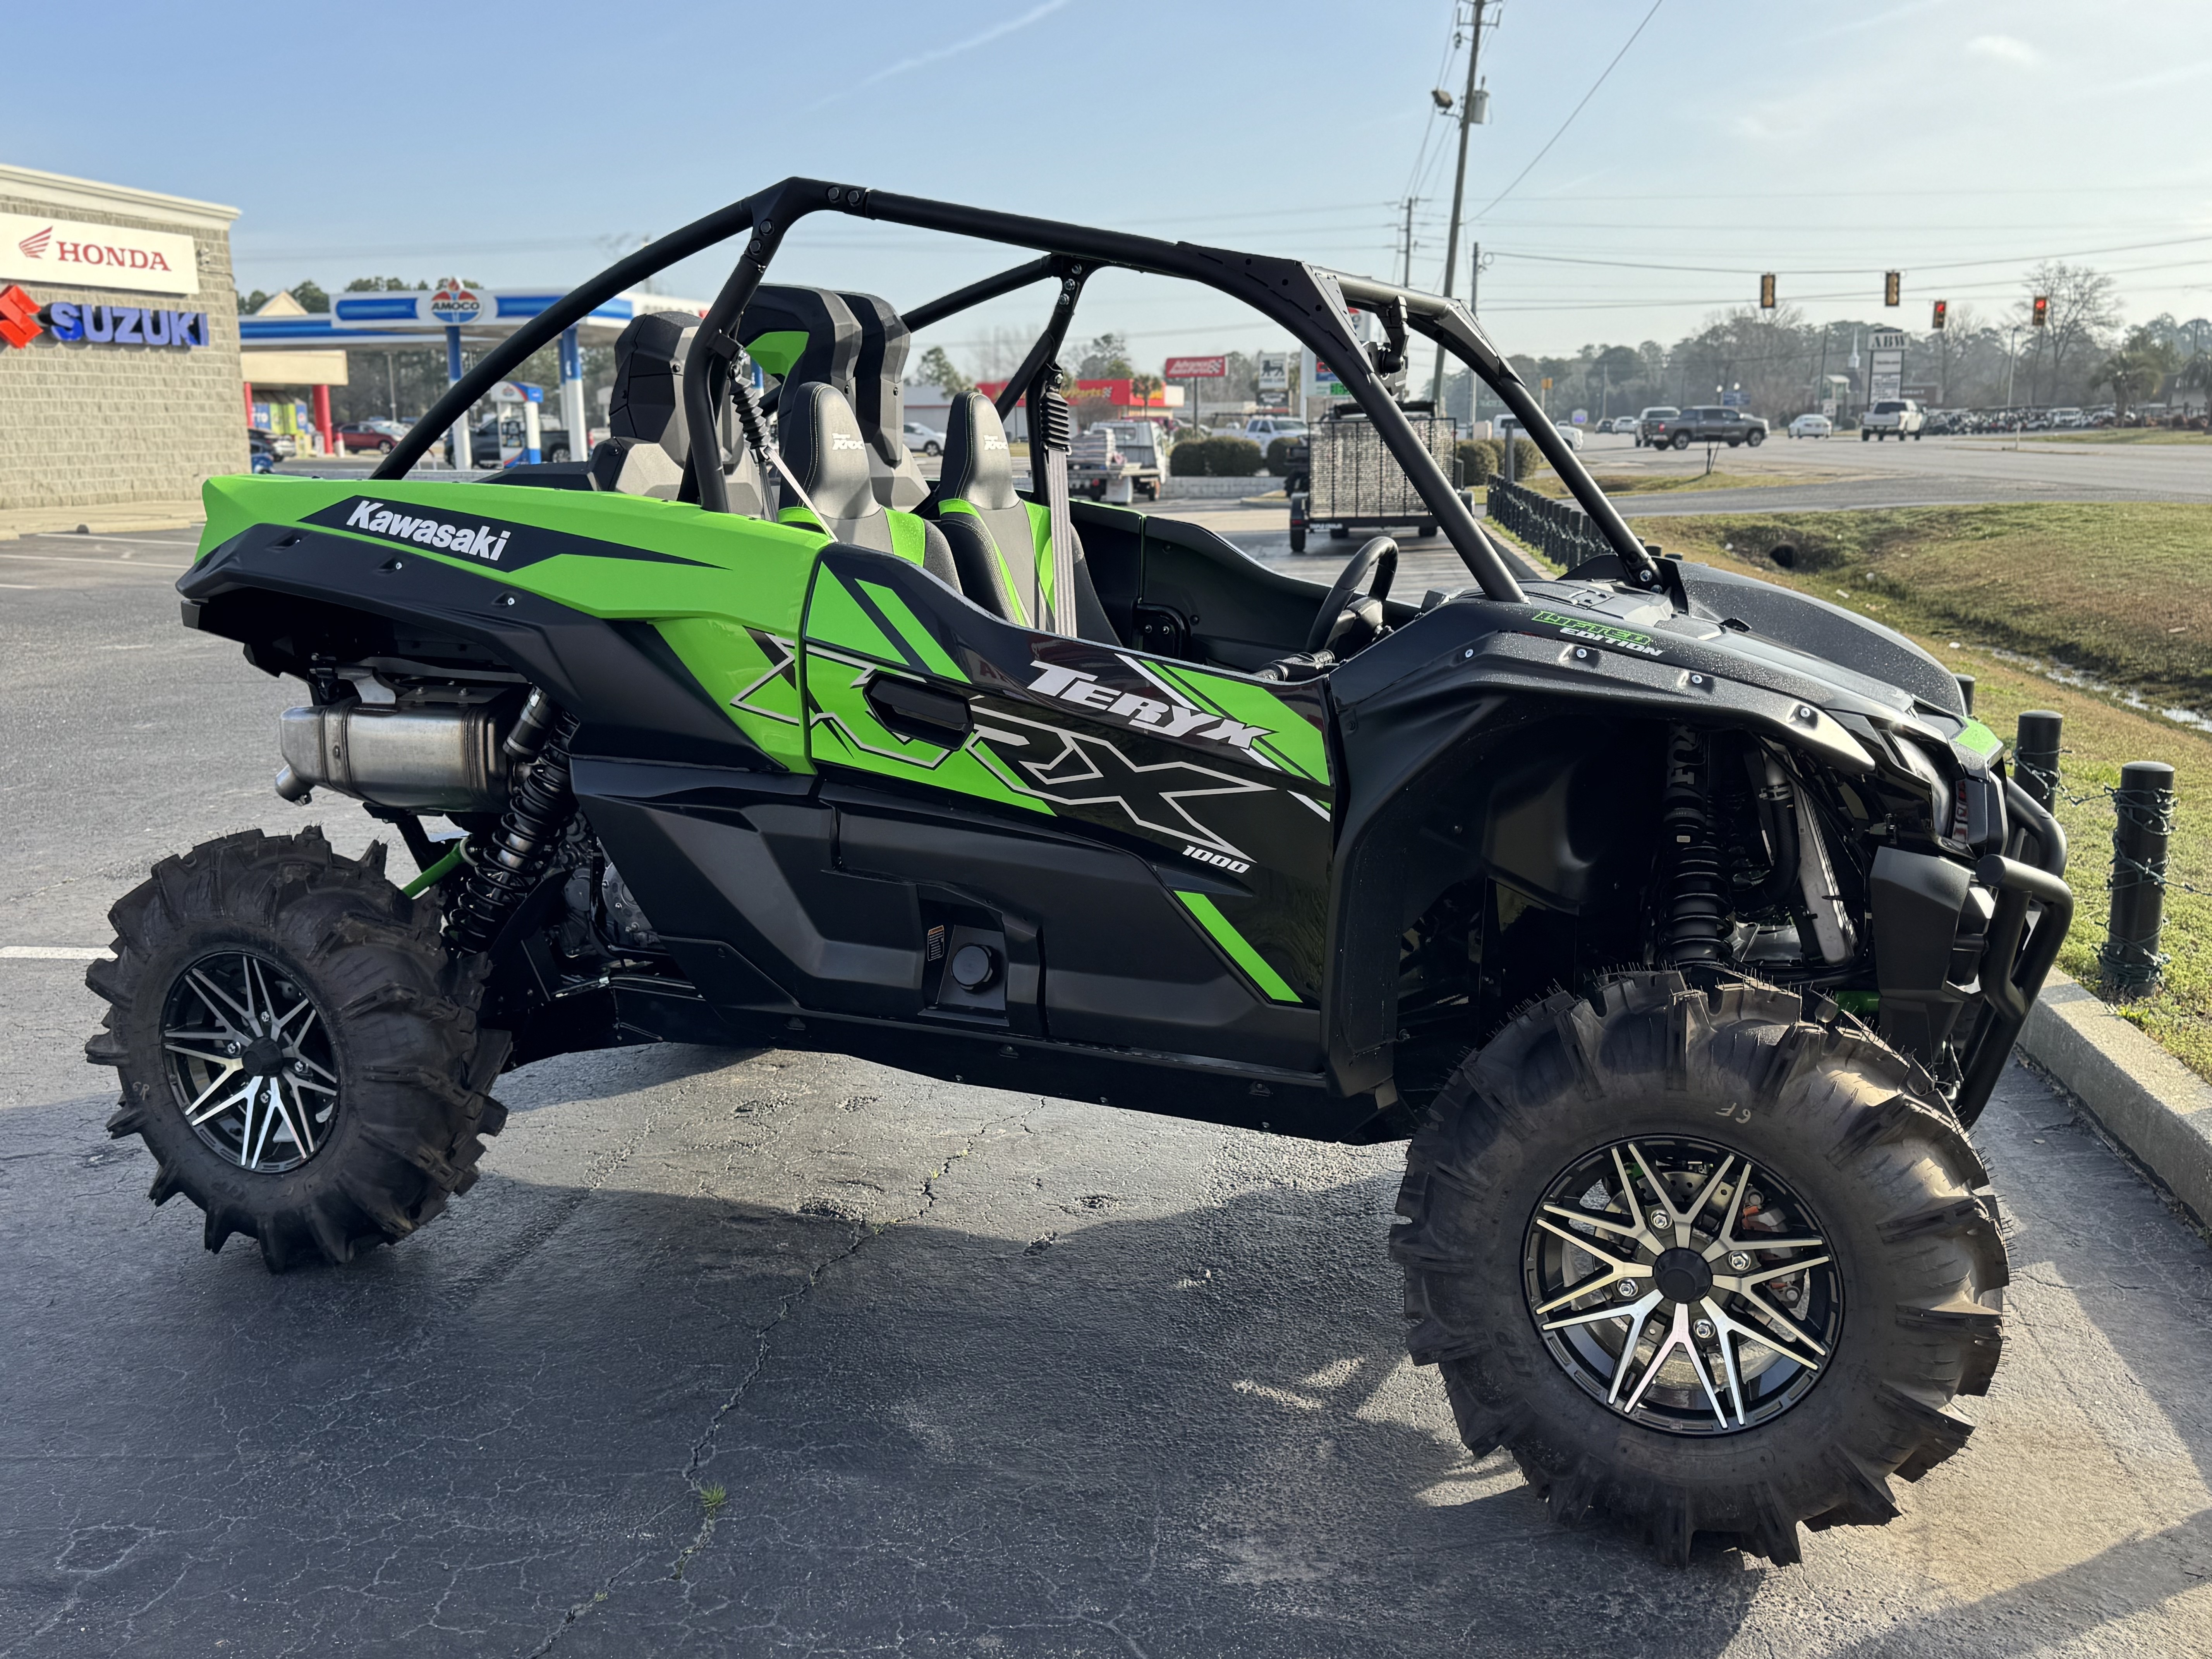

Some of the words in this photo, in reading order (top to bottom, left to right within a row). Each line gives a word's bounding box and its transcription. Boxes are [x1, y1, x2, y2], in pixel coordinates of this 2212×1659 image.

[56, 240, 172, 271] HONDA
[431, 302, 480, 310] AMOCO
[50, 301, 209, 346] SUZUKI
[346, 500, 511, 561] Kawasaki
[1531, 610, 1652, 646] LIFTED
[1559, 627, 1666, 656] EDITION
[1182, 845, 1250, 873] 1000
